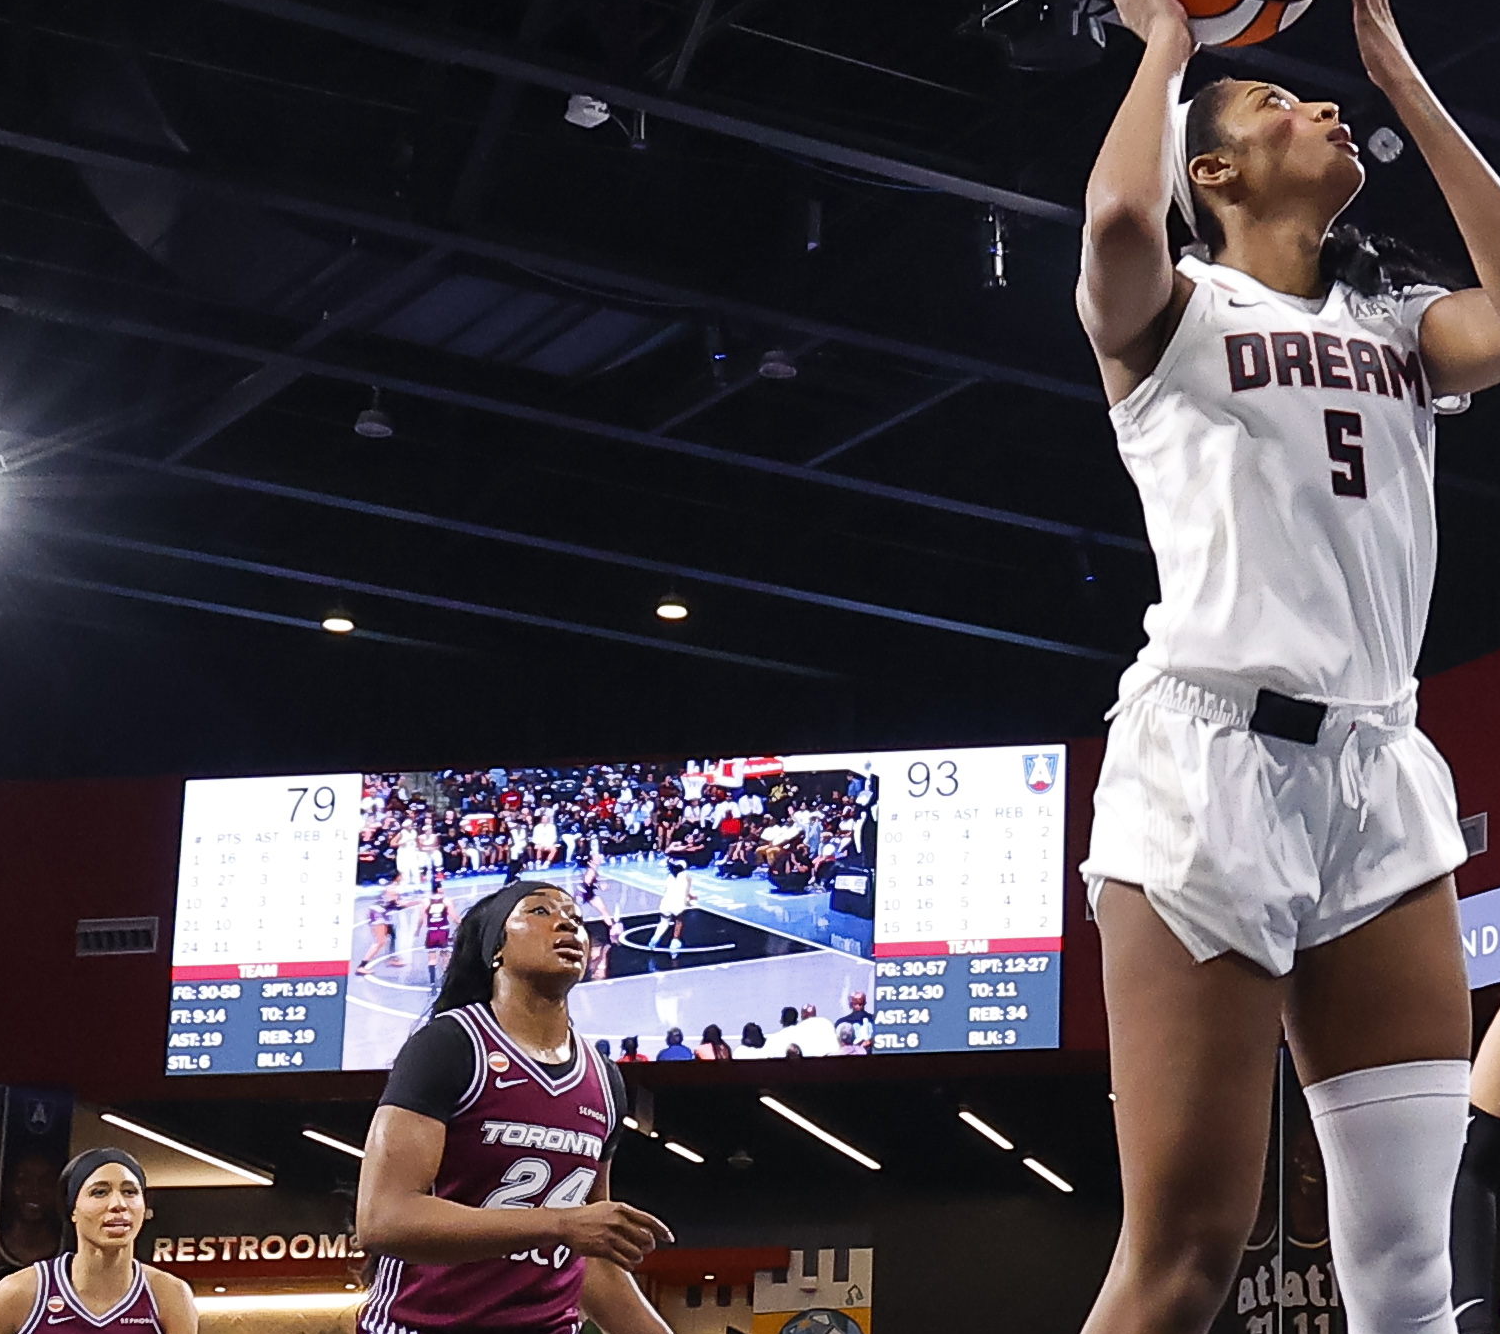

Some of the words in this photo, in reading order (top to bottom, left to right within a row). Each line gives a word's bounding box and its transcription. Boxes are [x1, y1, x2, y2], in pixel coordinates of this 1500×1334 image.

[1224, 331, 1428, 409] DREAM
[1324, 408, 1368, 500] 5
[907, 760, 959, 798] 93
[287, 786, 336, 822] 79
[946, 939, 989, 955] TEAM
[237, 964, 279, 979] TEAM
[876, 963, 901, 977] FG:
[902, 961, 947, 976] 30-57
[970, 959, 1003, 974] 3PT:
[1005, 957, 1049, 973] 12-27
[173, 986, 197, 1000] FG:
[198, 984, 242, 999] 30-58
[261, 982, 293, 997] 3PT:
[295, 981, 338, 997] 10-23
[876, 987, 897, 1001] FT:
[898, 985, 944, 1000] 21-30
[968, 983, 994, 997] TO:
[996, 982, 1018, 997] 11
[170, 1010, 192, 1024] FT:
[193, 1008, 227, 1023] 9-14
[260, 1007, 284, 1021] TO:
[285, 1006, 307, 1020] 12
[875, 1010, 907, 1025] AST:
[908, 1009, 930, 1024] 24
[969, 1007, 1004, 1022] REB:
[1006, 1006, 1028, 1021] 34
[169, 1033, 201, 1047] AST:
[201, 1032, 223, 1046] 19
[258, 1030, 292, 1044] REB:
[294, 1029, 316, 1043] 19
[874, 1033, 905, 1049] STL:
[907, 1033, 919, 1047] 6
[968, 1031, 1003, 1046] BLK:
[1004, 1029, 1016, 1044] 3
[167, 1055, 198, 1070] STL:
[199, 1054, 211, 1069] 6
[257, 1052, 290, 1067] BLK:
[291, 1051, 303, 1066] 4
[480, 1120, 604, 1162] TORONTO
[479, 1156, 598, 1209] 24
